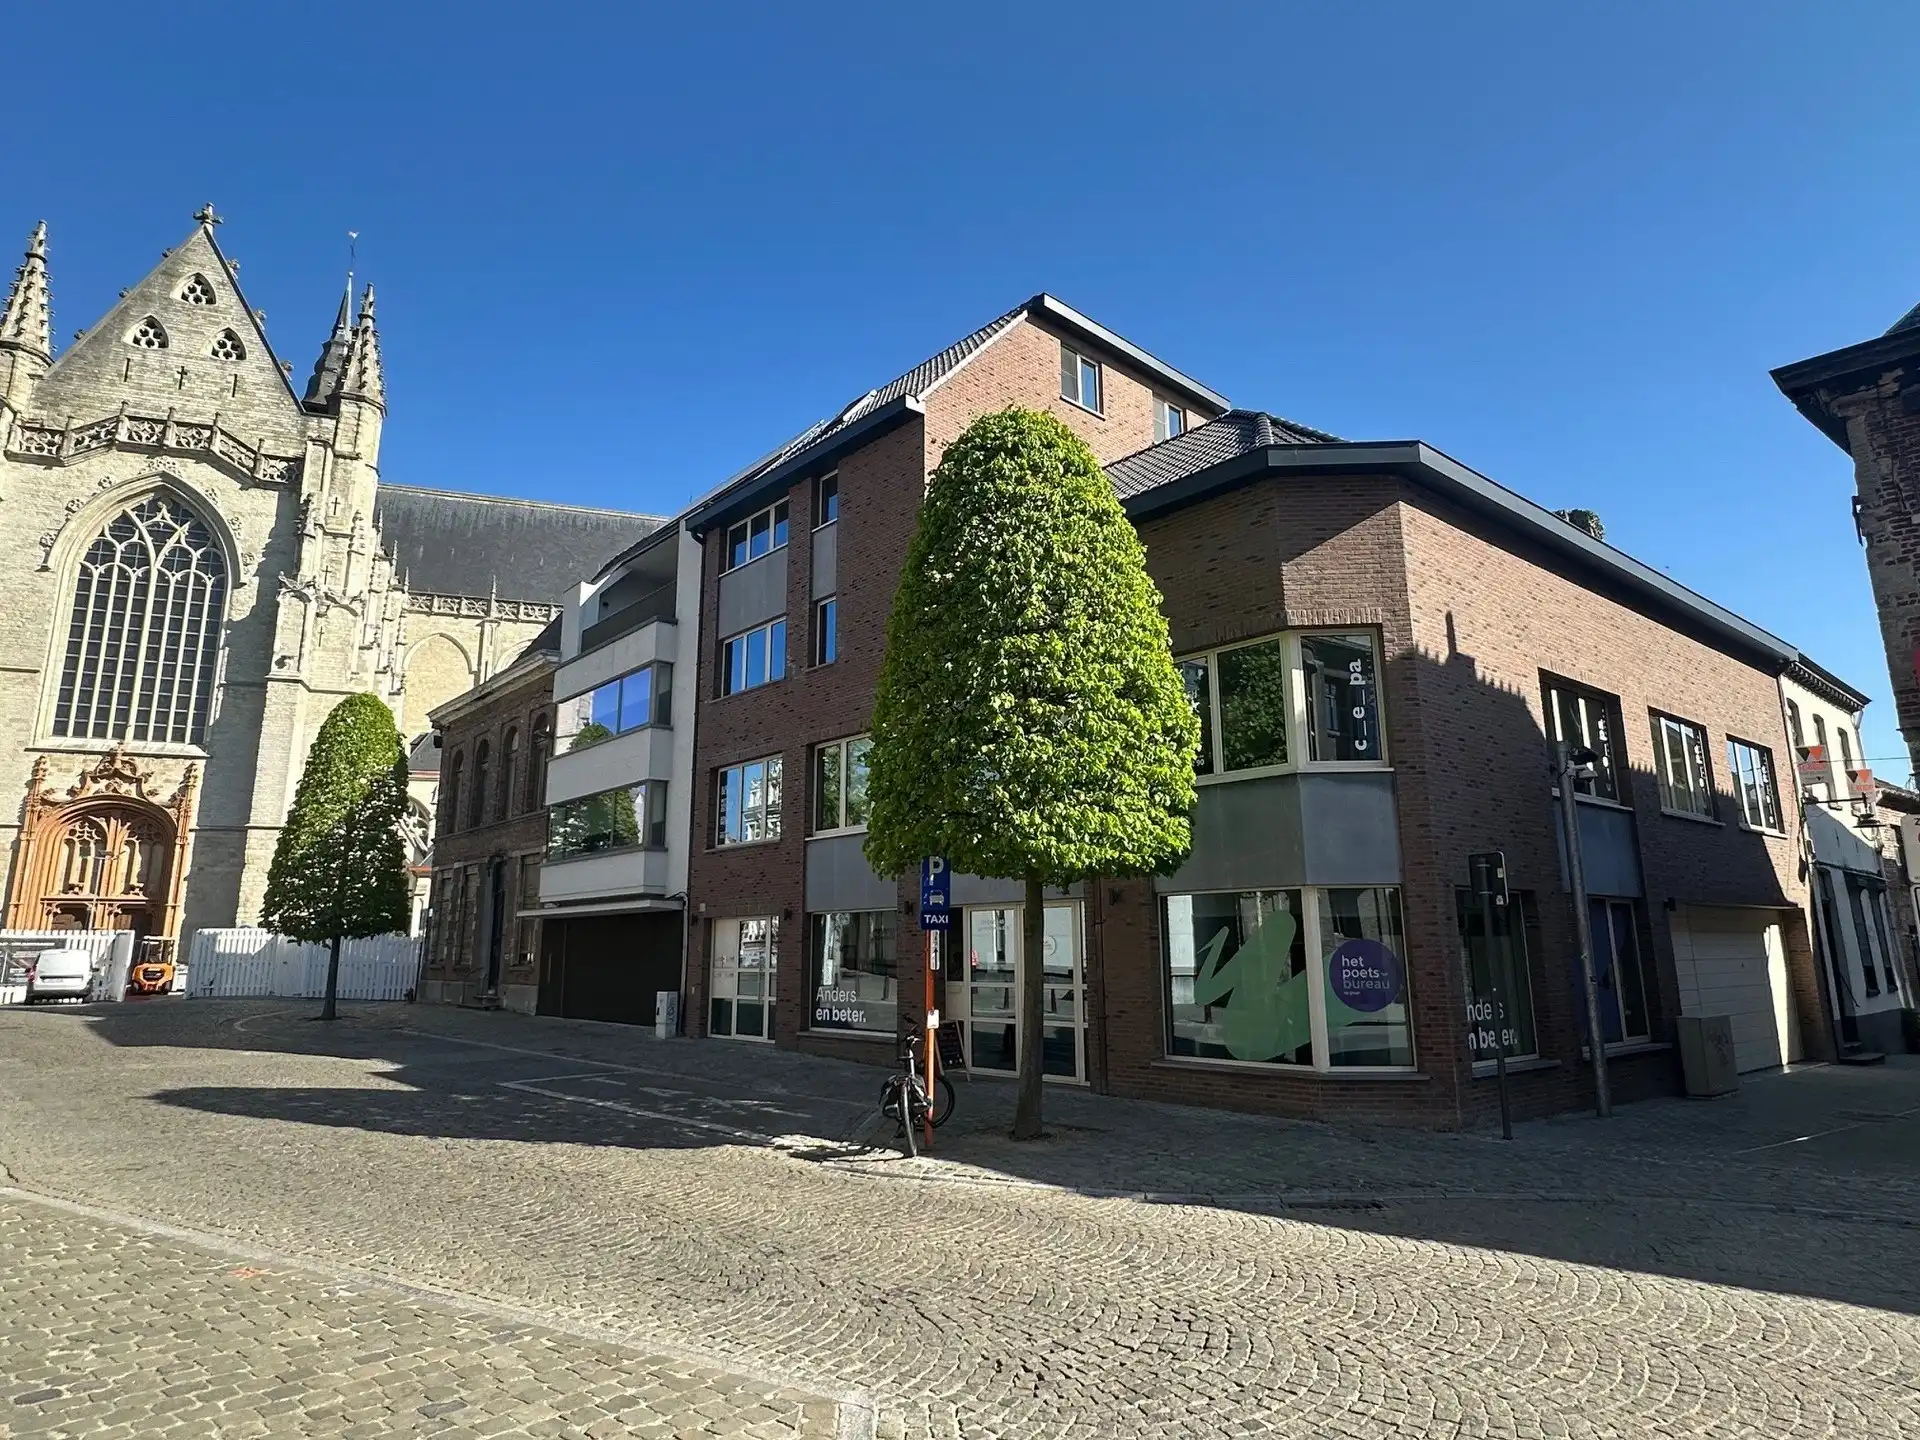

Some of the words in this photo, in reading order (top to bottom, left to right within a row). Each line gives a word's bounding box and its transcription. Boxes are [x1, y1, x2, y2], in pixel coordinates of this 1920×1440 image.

[924, 914, 949, 924] TAXI
[1341, 954, 1364, 967] het
[1342, 967, 1380, 980] poets
[1343, 979, 1391, 989] bureau
[815, 986, 857, 1003] Anders
[815, 1009, 829, 1021] en
[832, 1006, 867, 1023] beter.
[1478, 1026, 1518, 1050] beer.
